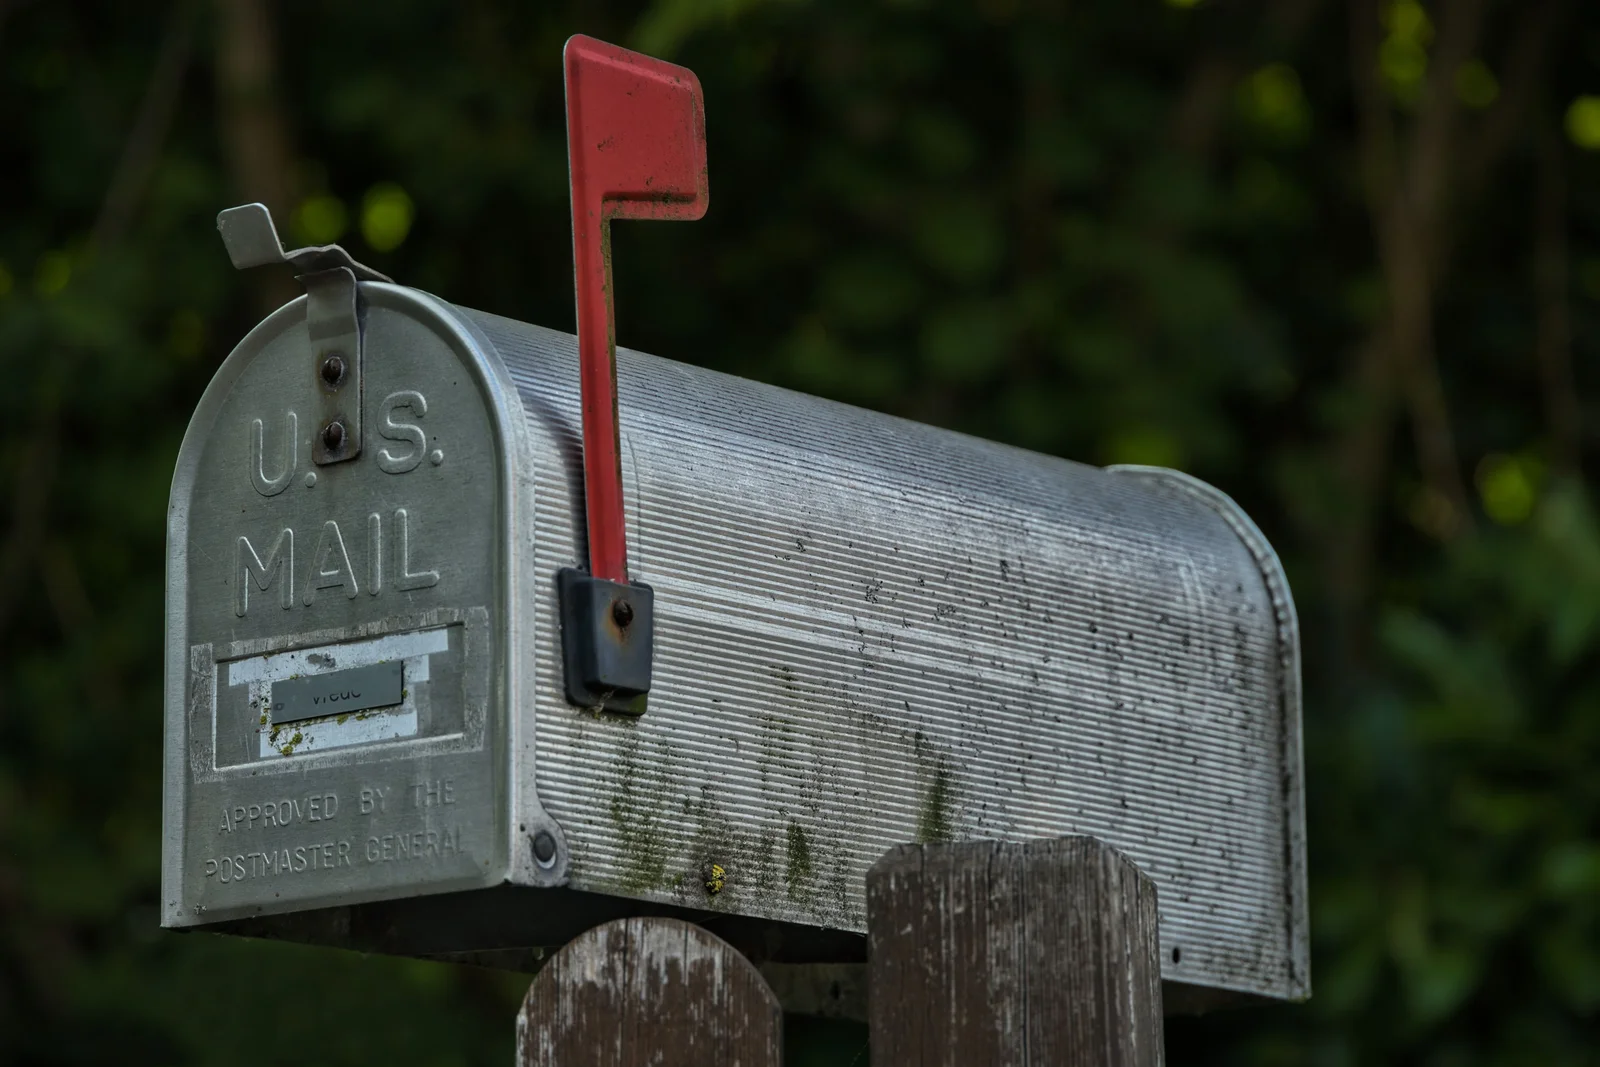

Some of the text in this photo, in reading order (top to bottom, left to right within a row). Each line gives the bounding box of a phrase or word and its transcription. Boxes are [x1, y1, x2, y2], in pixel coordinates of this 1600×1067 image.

[251, 389, 444, 497] U. S.
[235, 508, 440, 617] MAIL
[219, 779, 455, 835] APPROVED BY THE
[205, 828, 465, 884] POSTMASTER GENERAL
